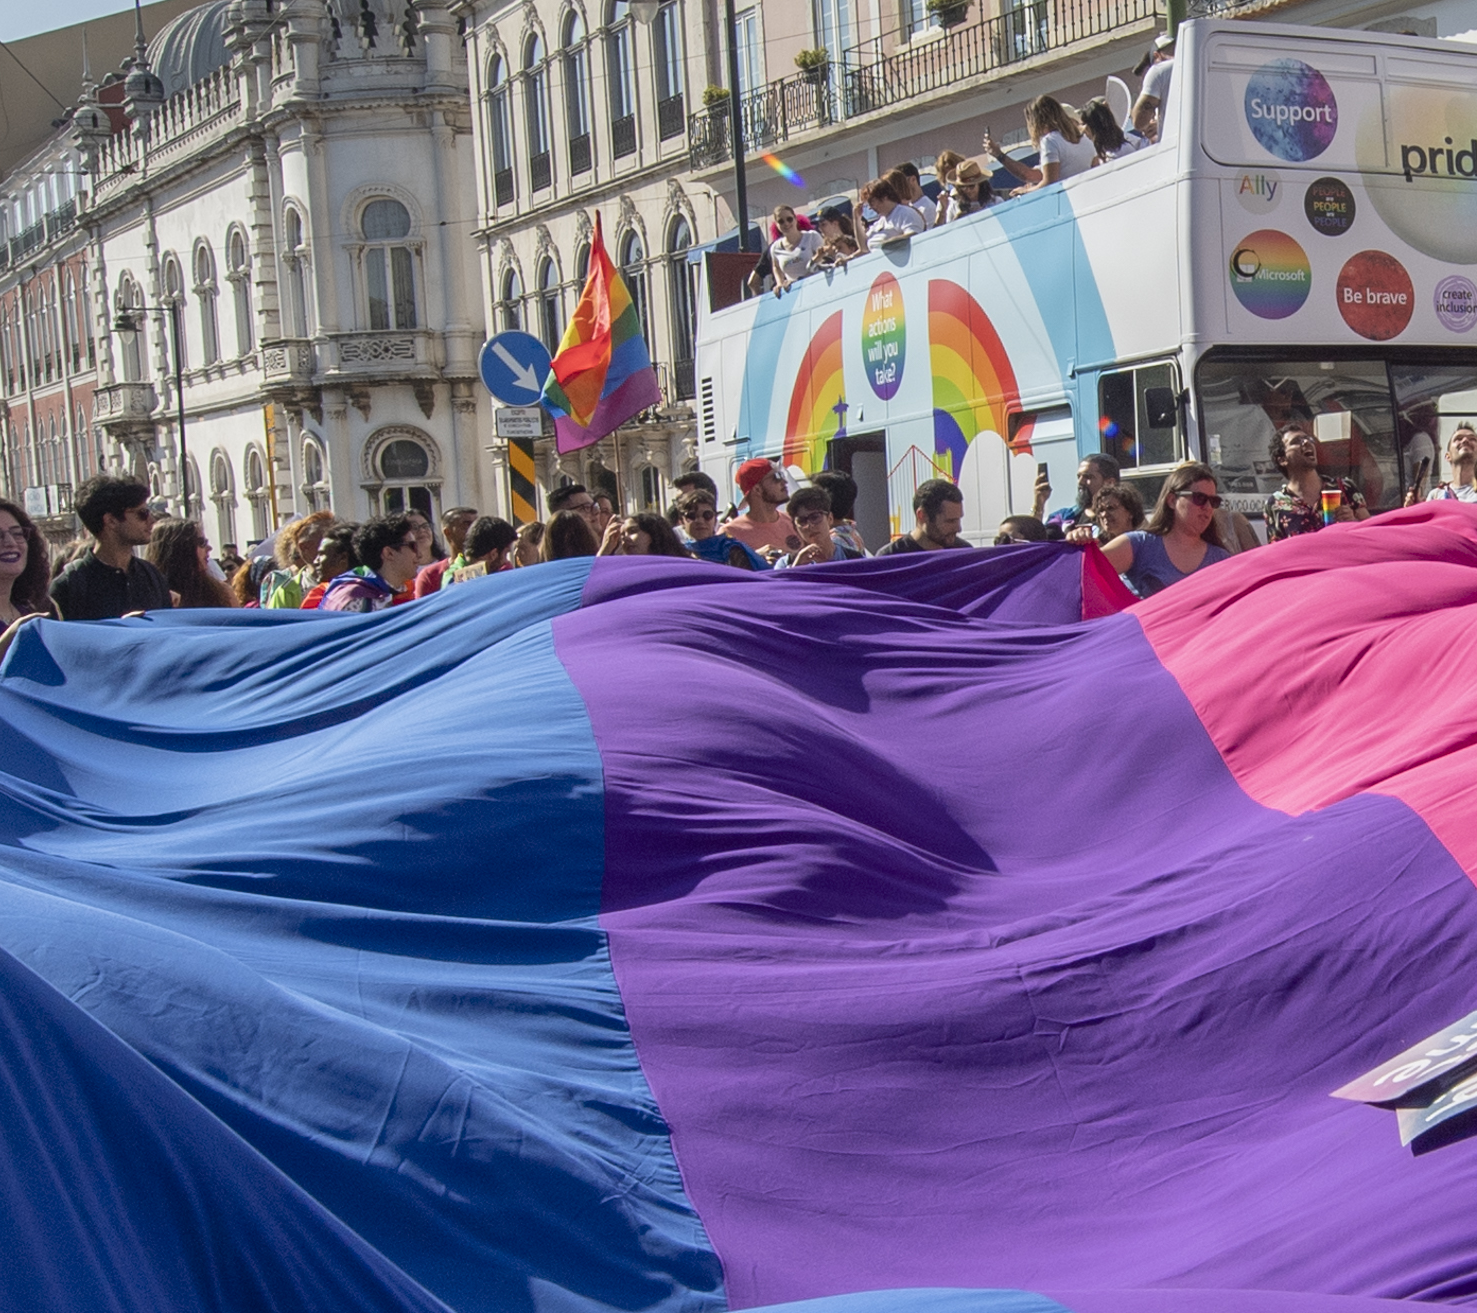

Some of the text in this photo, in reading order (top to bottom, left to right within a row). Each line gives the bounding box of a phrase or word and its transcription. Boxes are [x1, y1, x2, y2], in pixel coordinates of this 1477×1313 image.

[1250, 99, 1333, 126] Support
[1239, 174, 1277, 201] Ally
[1312, 188, 1346, 198] PEOPLE
[1313, 201, 1347, 213] PEOPLE
[1314, 216, 1347, 227] PEOPLE
[871, 290, 893, 312] What
[1343, 287, 1407, 305] Be brave
[1442, 290, 1473, 301] create
[868, 315, 897, 338] actions
[867, 340, 898, 364] will you
[875, 362, 896, 385] take?
